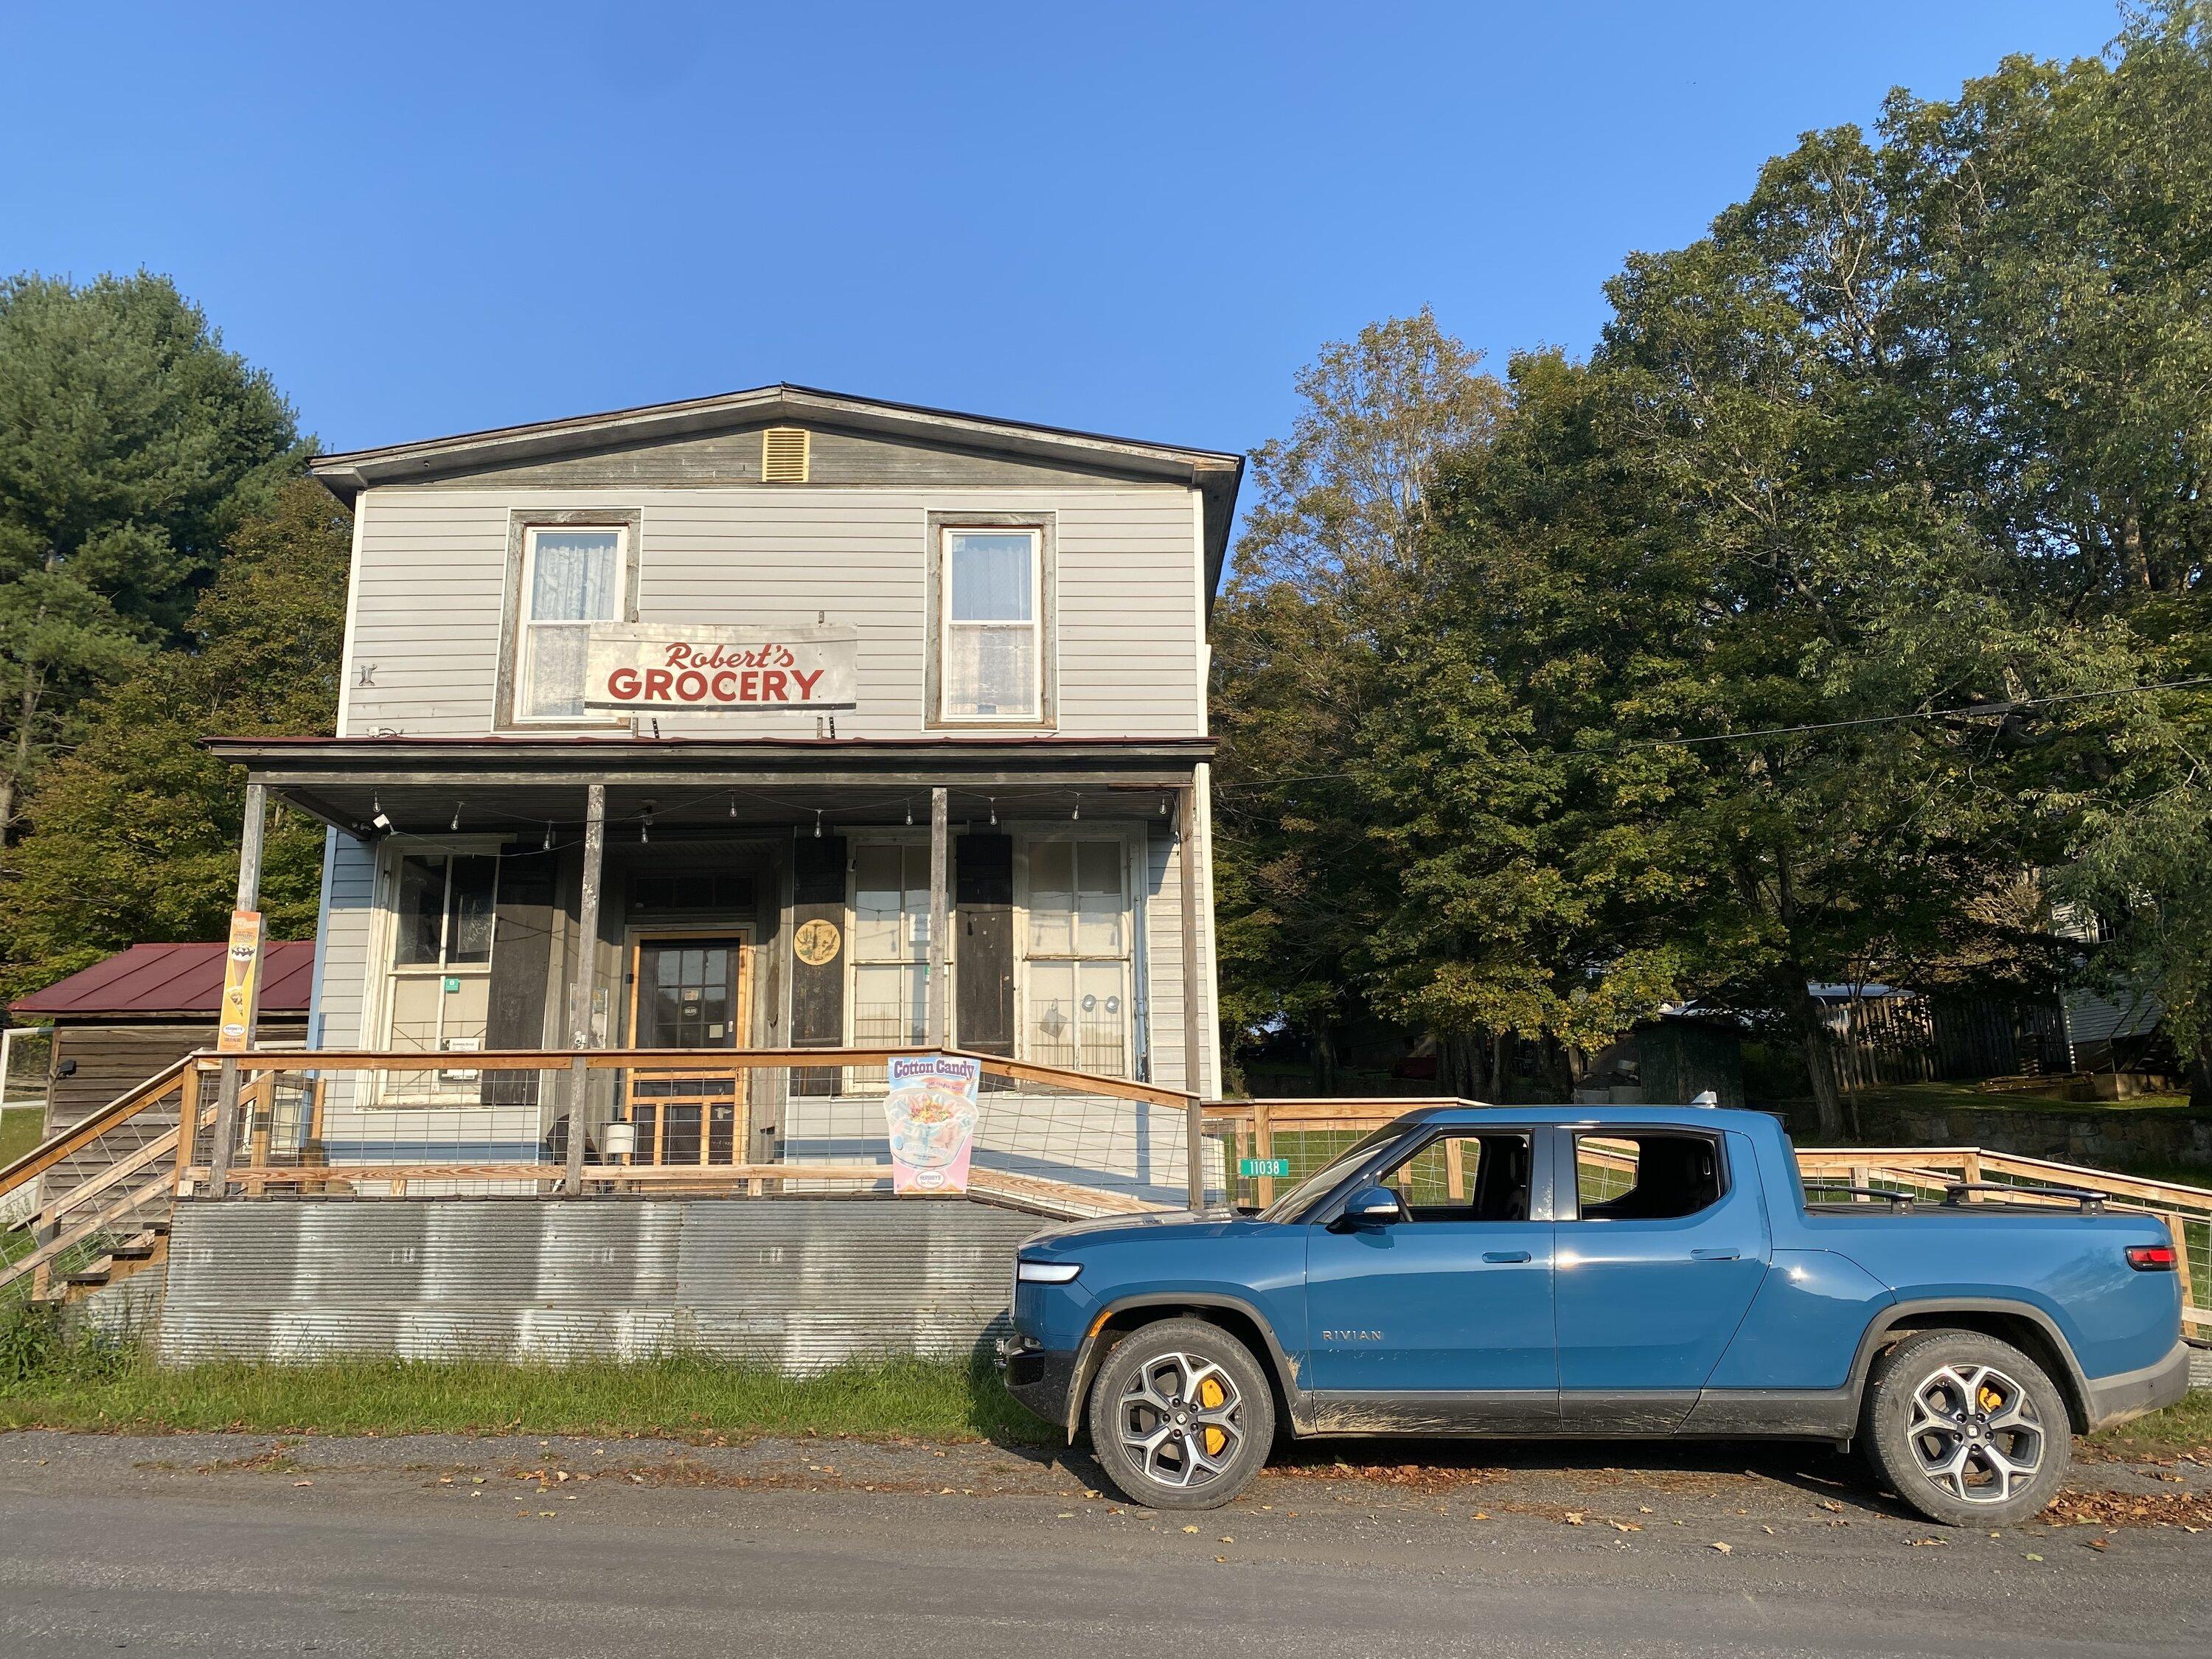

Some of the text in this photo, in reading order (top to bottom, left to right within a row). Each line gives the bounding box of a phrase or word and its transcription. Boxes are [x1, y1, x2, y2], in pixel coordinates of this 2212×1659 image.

[665, 642, 794, 669] Robert's
[608, 668, 825, 701] GROCERY
[894, 1060, 975, 1079] Cotton Candy
[1250, 1161, 1280, 1175] 11038
[1322, 1330, 1381, 1340] RIVIAN
